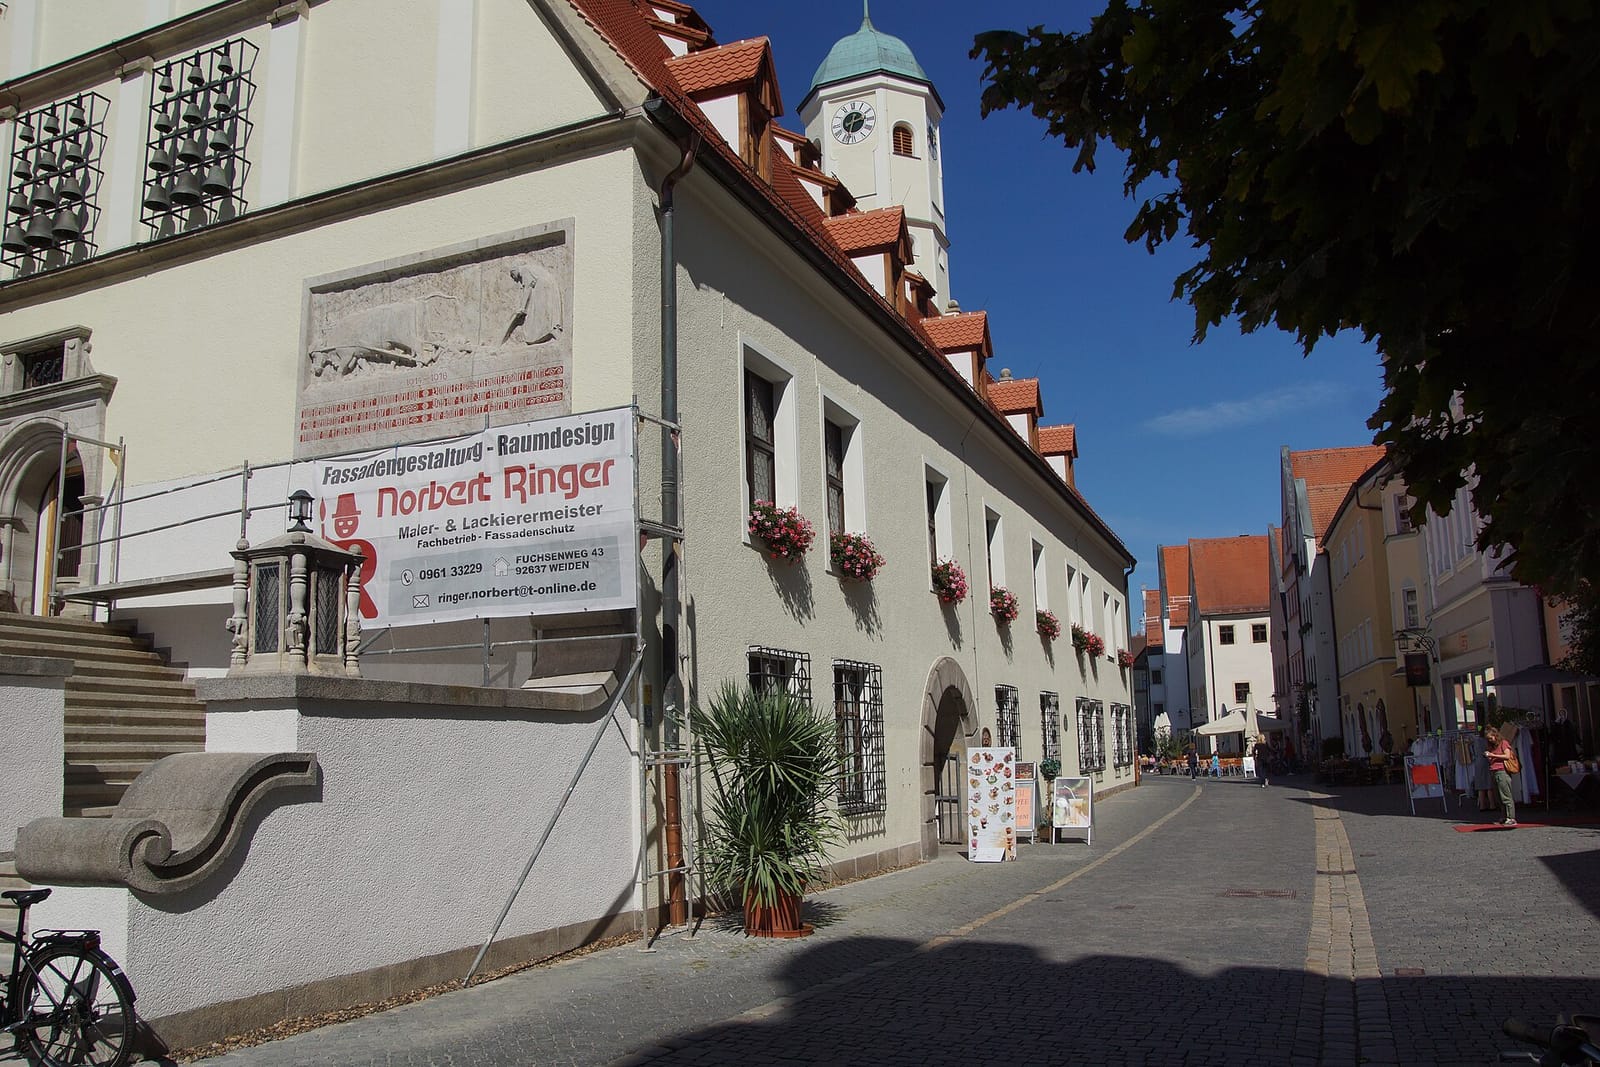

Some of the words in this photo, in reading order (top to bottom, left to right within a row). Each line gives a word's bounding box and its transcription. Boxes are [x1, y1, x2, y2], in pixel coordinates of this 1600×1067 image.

[497, 422, 616, 457] Raumdesign
[504, 459, 615, 504] Ringer
[398, 523, 440, 540] Maler-
[445, 518, 457, 533] &
[462, 504, 603, 530] Lackierermeister
[417, 534, 478, 549] Fachbetrieb
[484, 524, 575, 540] Fassadenschutz
[515, 549, 589, 564] FUCHSENWEG
[591, 547, 604, 557] 43
[515, 564, 547, 575] 92637
[549, 560, 590, 573] WEIDEN
[419, 567, 447, 581] 0961
[450, 562, 483, 577] 33229
[438, 580, 597, 604] ringer.norbert@t-online.de
